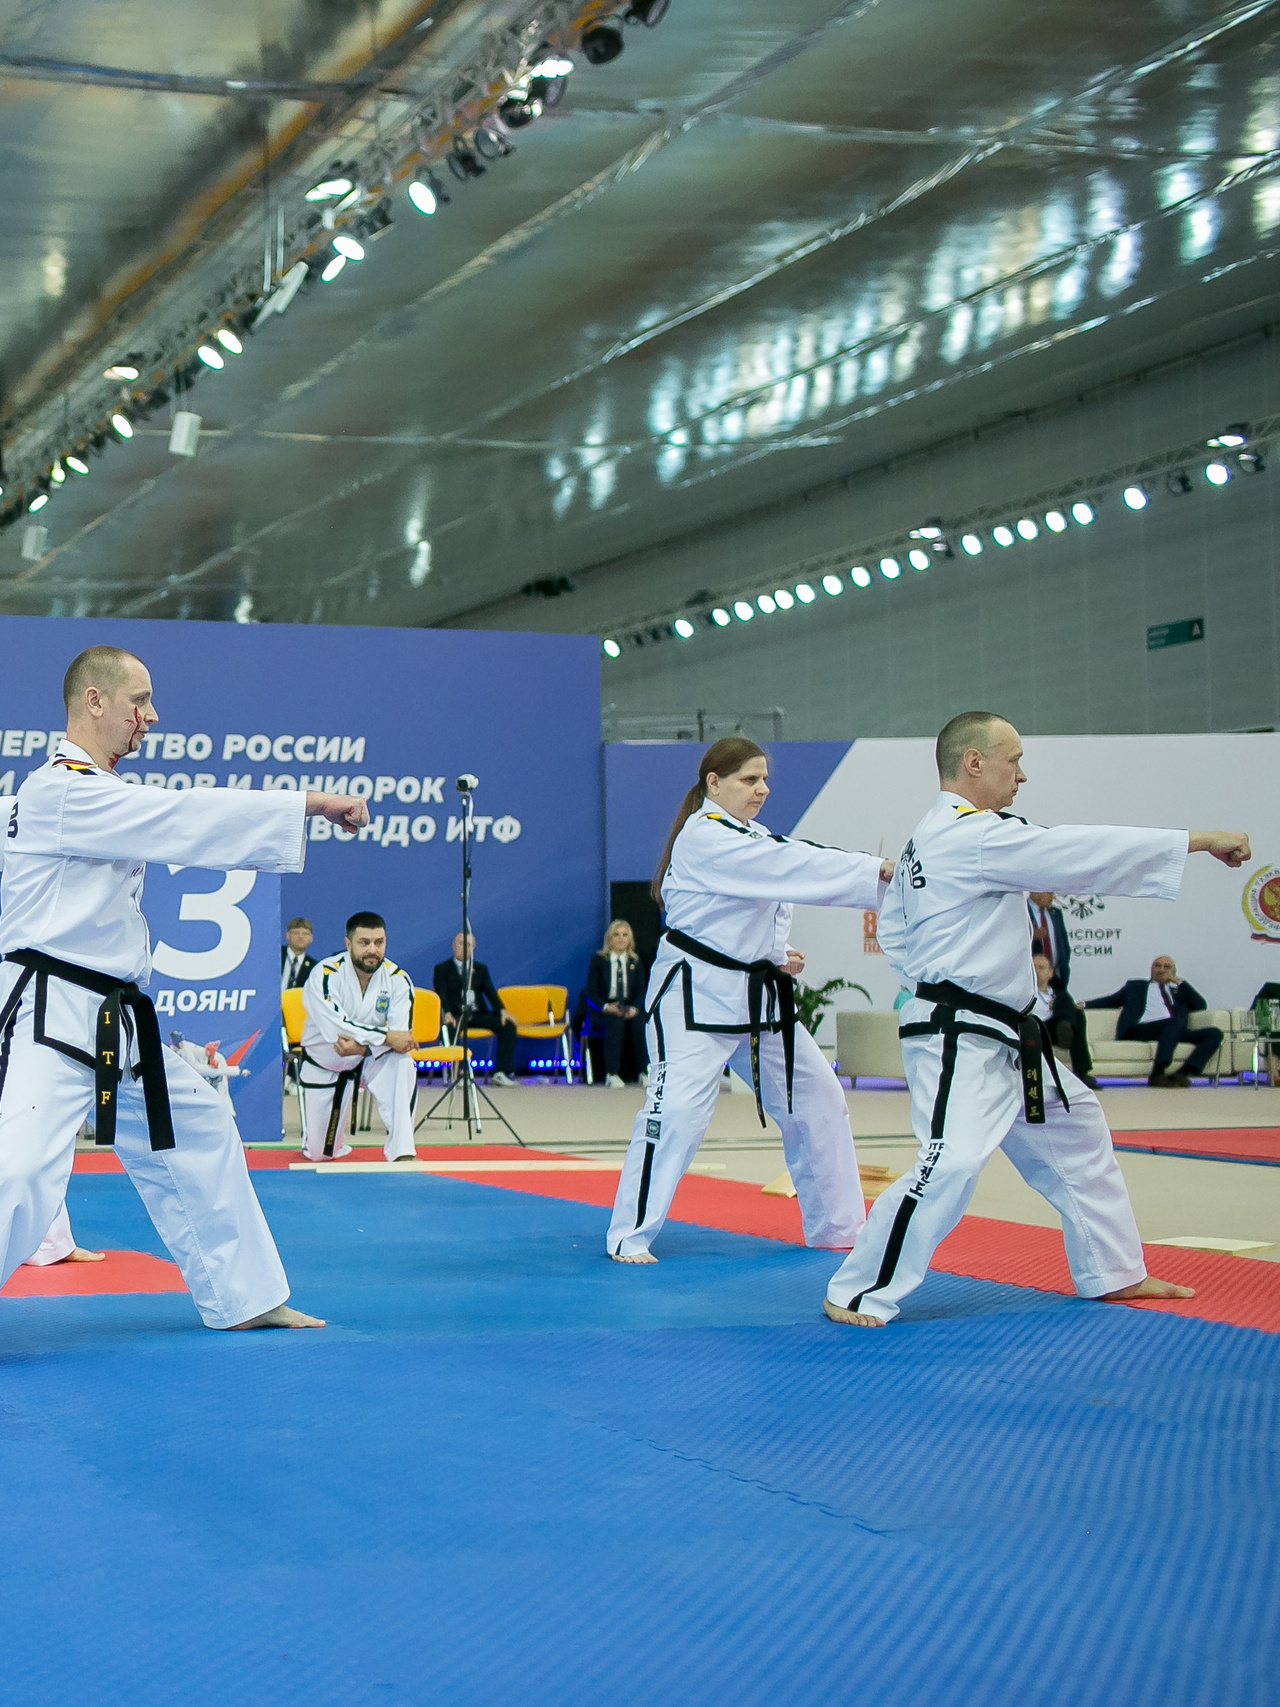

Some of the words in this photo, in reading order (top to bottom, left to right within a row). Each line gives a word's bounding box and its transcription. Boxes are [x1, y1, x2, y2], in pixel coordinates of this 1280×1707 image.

[222, 733, 366, 763] РОССИИ
[263, 775, 446, 803] ЮНИОРОК
[446, 815, 521, 844] ИТФ
[152, 862, 257, 980] 3
[1073, 944, 1113, 957] ССИИ
[154, 989, 256, 1017] ДОЯНГ
